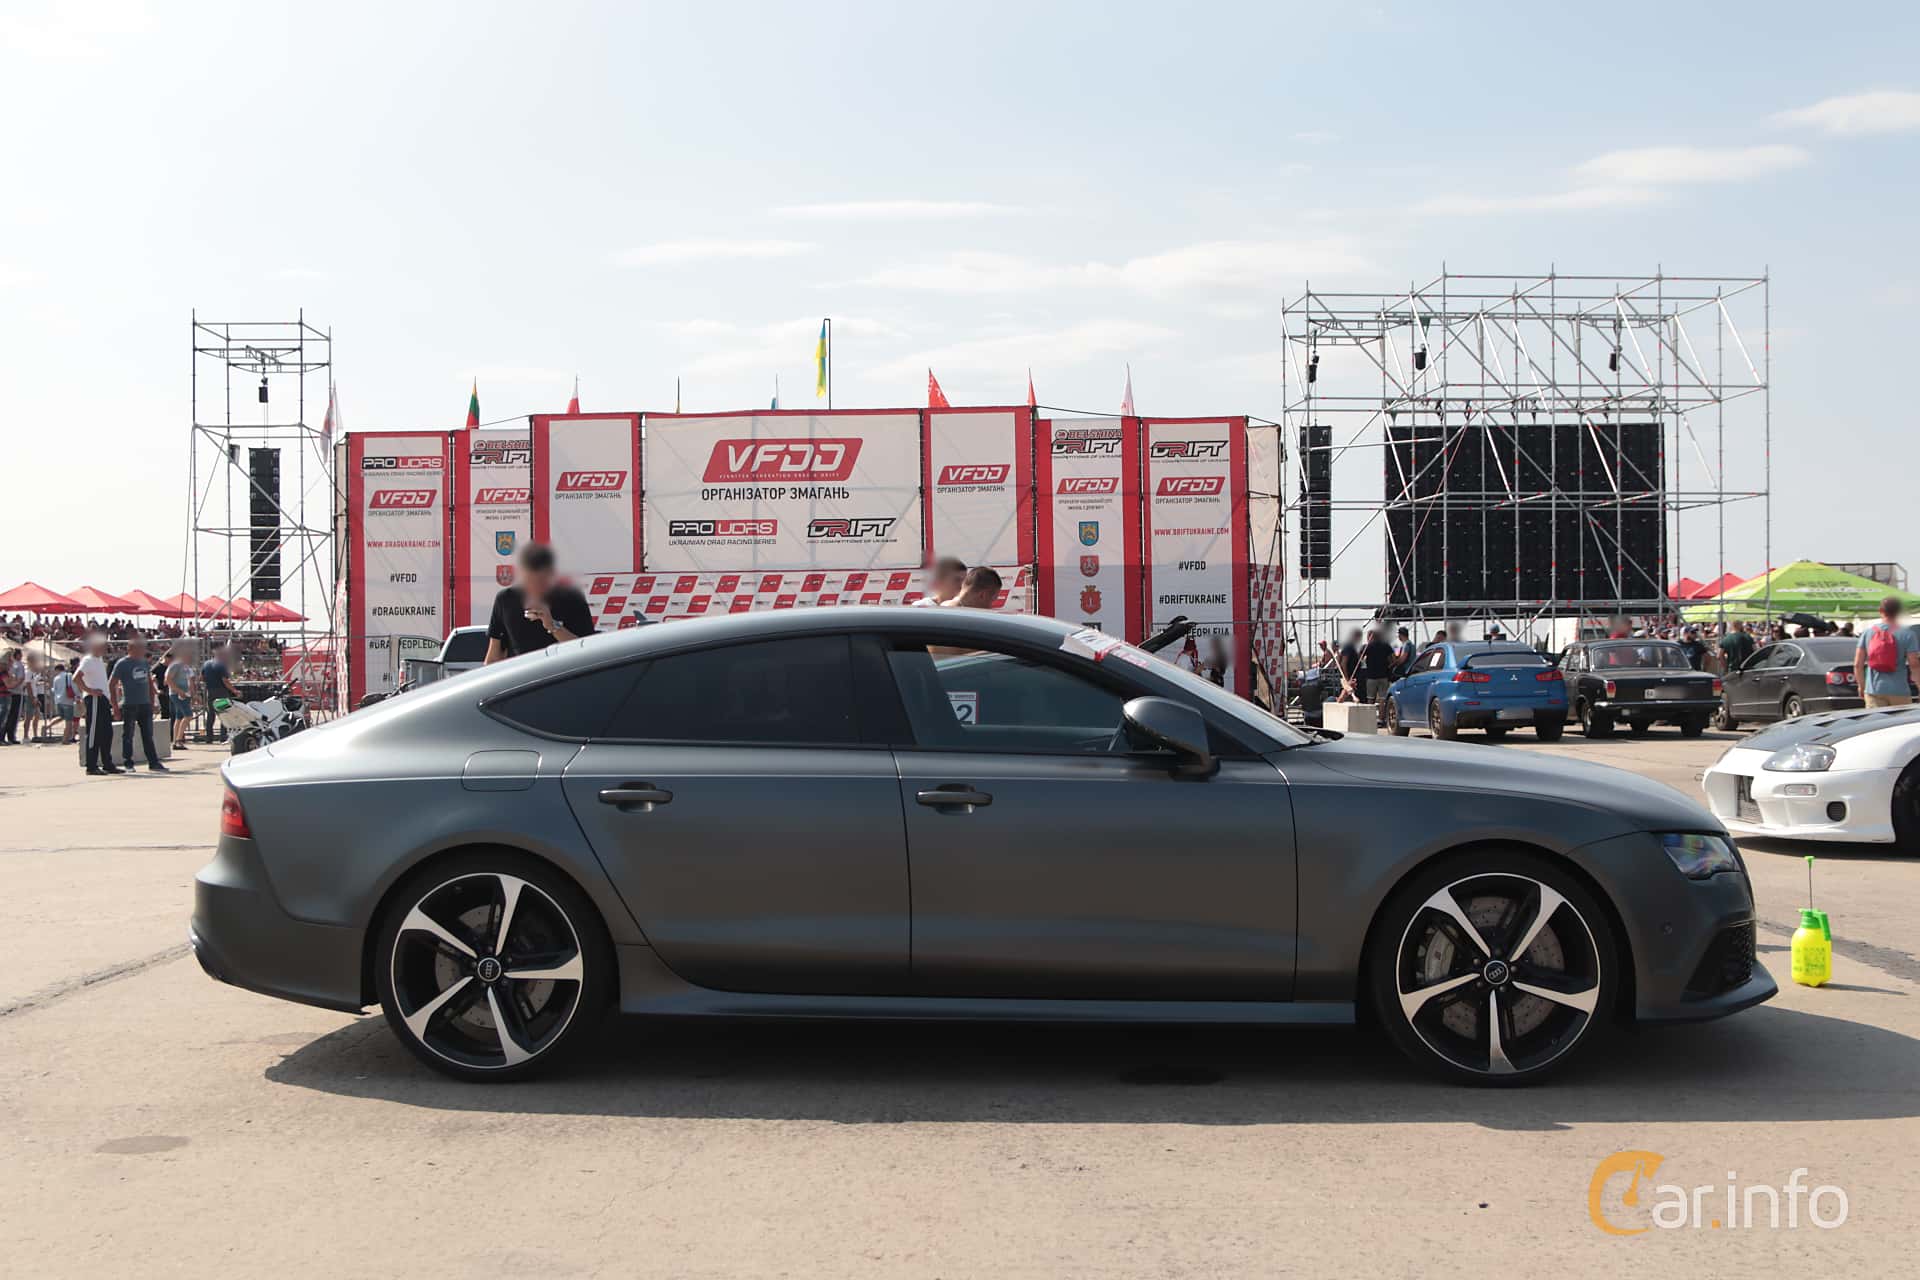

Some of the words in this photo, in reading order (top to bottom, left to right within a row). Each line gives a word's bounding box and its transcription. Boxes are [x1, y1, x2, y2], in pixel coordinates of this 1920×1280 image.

[1051, 439, 1121, 454] DRIFT
[1151, 441, 1228, 457] DRIFT
[362, 457, 397, 468] PRO
[728, 443, 846, 473] VFDD
[567, 472, 620, 487] VFDD
[949, 466, 1003, 481] VFDD
[1065, 479, 1114, 492] VFDD
[1166, 479, 1219, 492] VFDD
[380, 492, 430, 505] VFDD
[483, 489, 530, 502] VFDD
[701, 488, 786, 501] ОРГАНІЗАТОР
[790, 487, 850, 500] ЗМАГАНЬ
[671, 521, 715, 535] PRO
[807, 518, 897, 537] DRIFT
[1154, 527, 1229, 537] WWW.DRIFTUKRAINE.COM
[367, 540, 440, 549] WWW.DRAGUKRAINE.COM
[1178, 560, 1206, 571] #VFDD
[390, 573, 417, 583] #VFDD
[1159, 594, 1227, 605] #DRIFTUKRAINE
[372, 606, 437, 617] #DRAGUKRAINE
